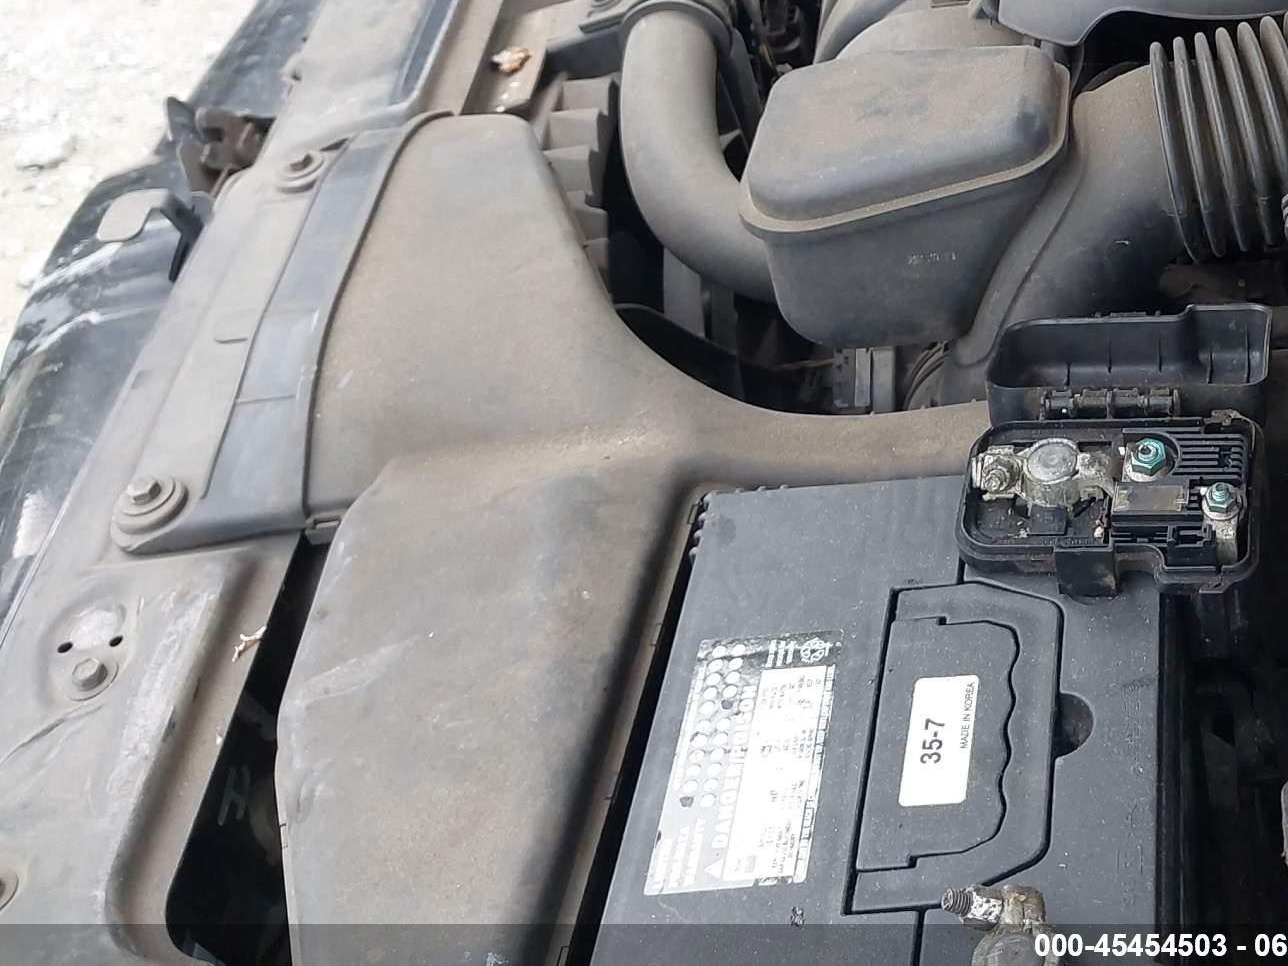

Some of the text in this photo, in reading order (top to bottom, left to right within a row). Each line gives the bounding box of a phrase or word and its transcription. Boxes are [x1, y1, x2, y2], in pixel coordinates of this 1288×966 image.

[919, 718, 946, 764] 35-7
[959, 681, 975, 749] MADE IN KOREA
